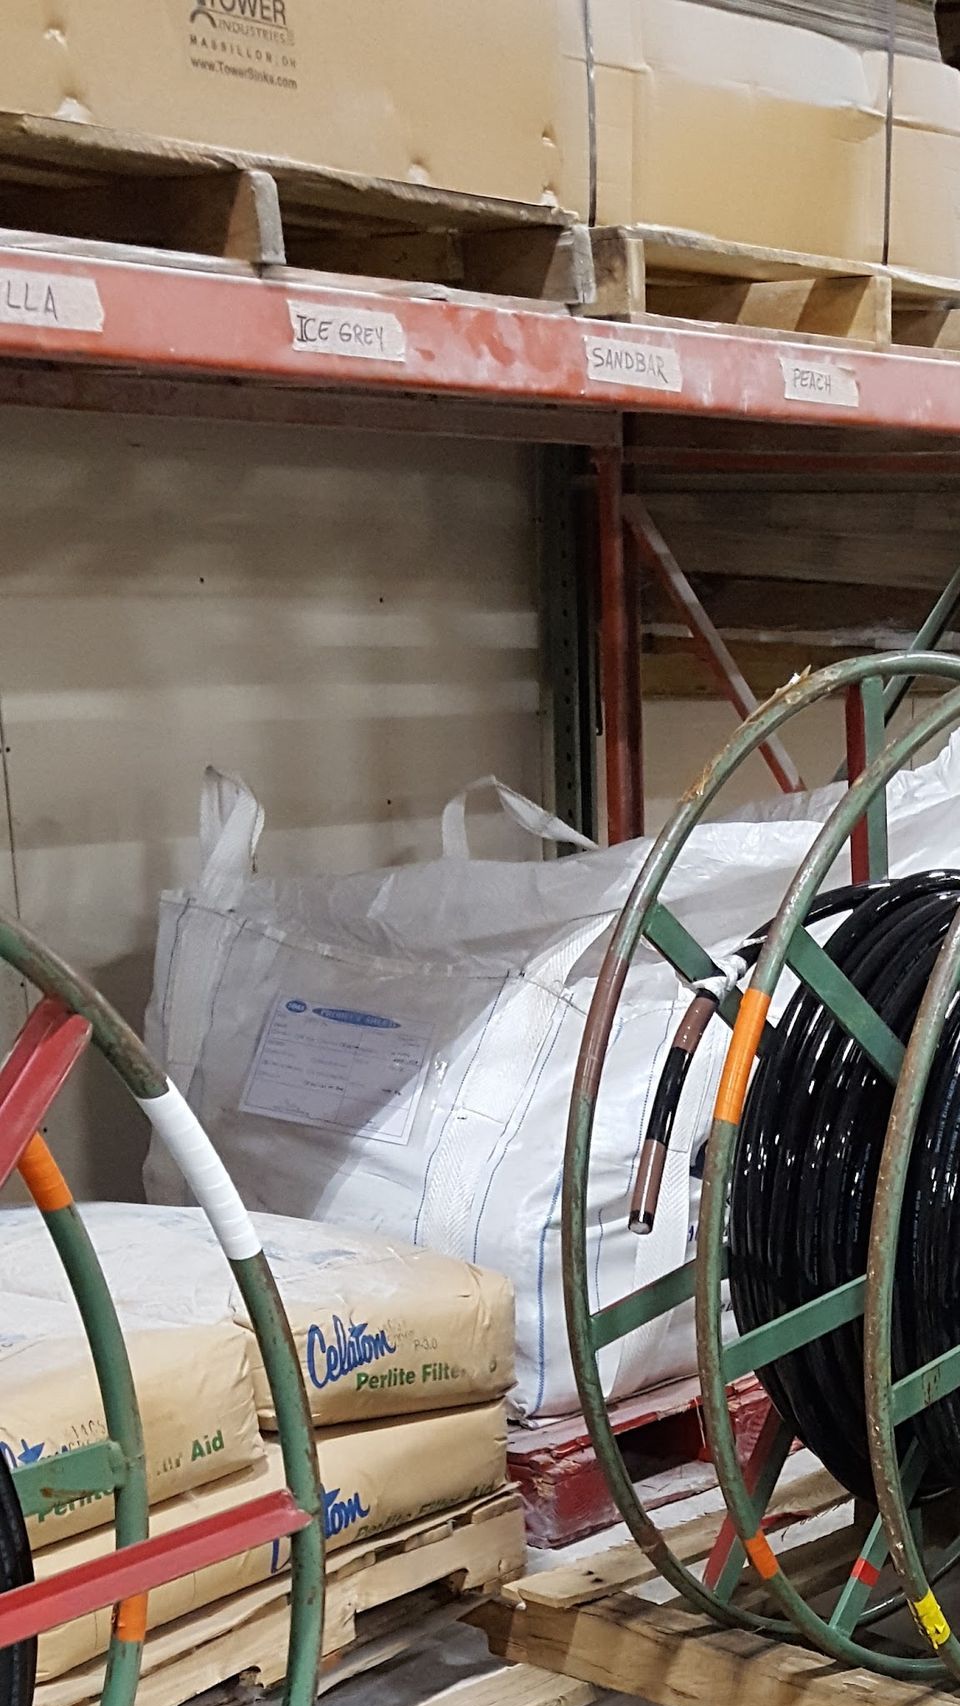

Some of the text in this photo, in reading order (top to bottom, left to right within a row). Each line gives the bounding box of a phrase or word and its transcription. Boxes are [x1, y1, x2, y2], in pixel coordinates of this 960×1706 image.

[296, 314, 384, 352] ICE GREY
[592, 347, 669, 384] SANDBAR
[793, 367, 832, 394] PEACH
[307, 1314, 396, 1389] Celatom
[355, 1366, 417, 1391] Perlite
[190, 1429, 225, 1462] Aid
